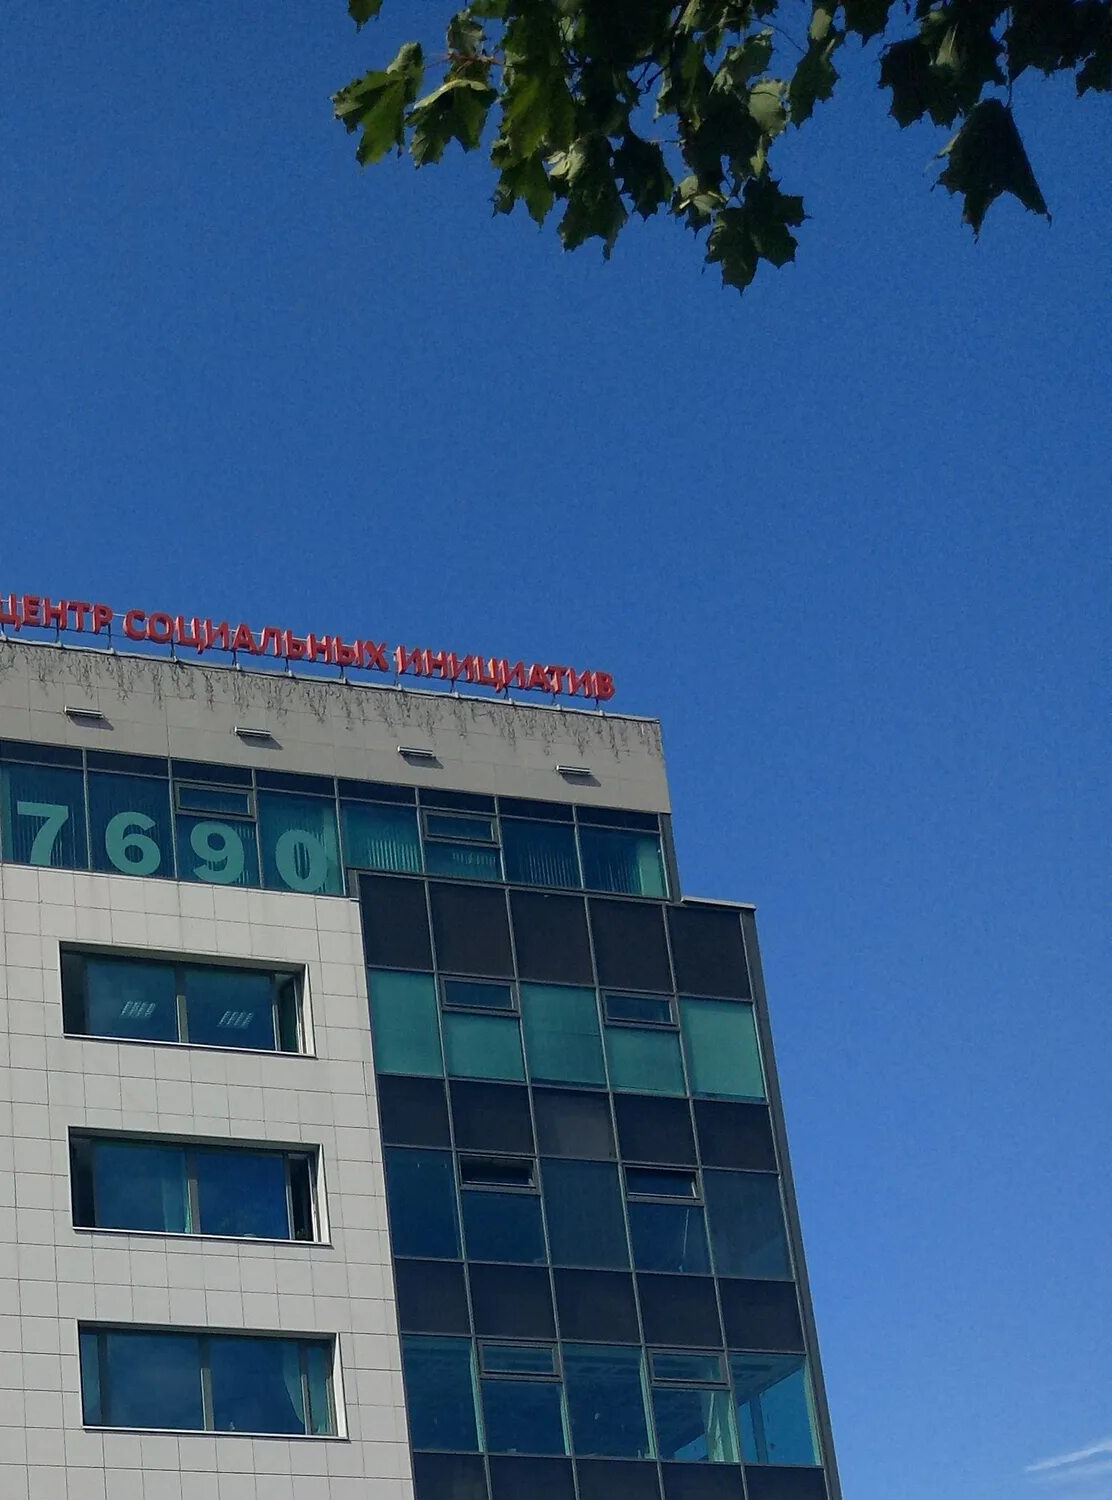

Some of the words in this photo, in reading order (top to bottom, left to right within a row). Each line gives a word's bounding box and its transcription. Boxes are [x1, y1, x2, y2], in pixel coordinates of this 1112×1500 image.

[122, 608, 390, 671] СОЦИАЛЬНЫХ
[395, 645, 617, 701] ИНИЦИАТИВ
[16, 801, 329, 894] 7690
